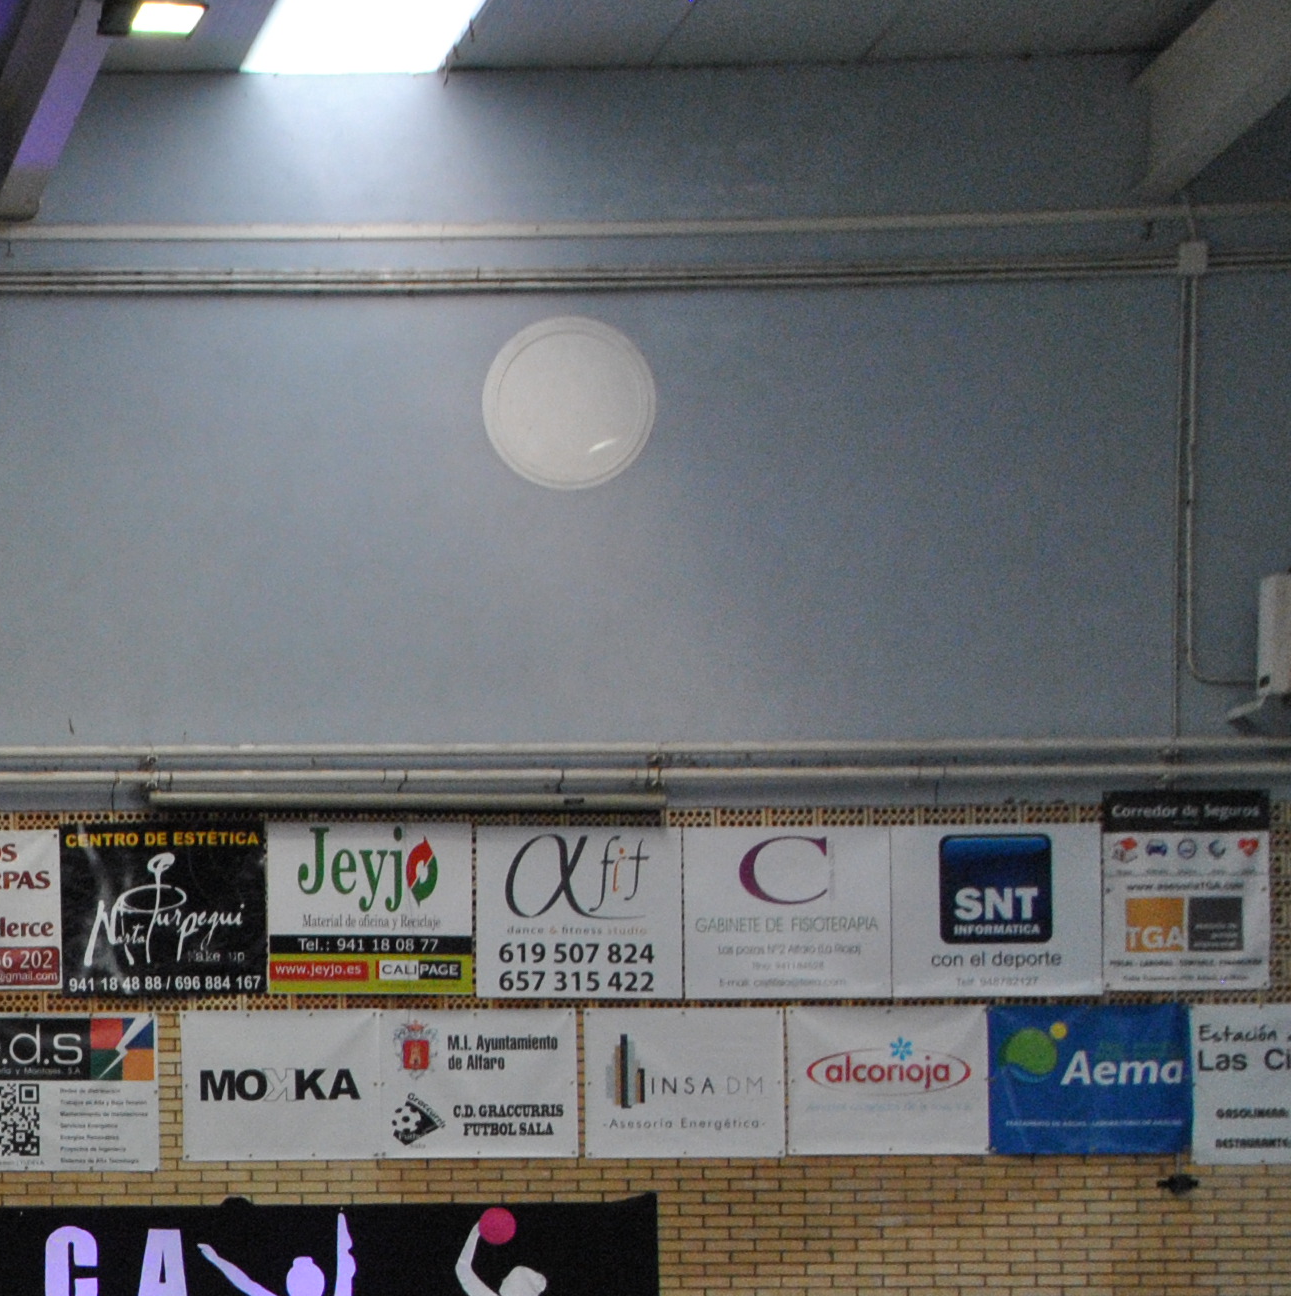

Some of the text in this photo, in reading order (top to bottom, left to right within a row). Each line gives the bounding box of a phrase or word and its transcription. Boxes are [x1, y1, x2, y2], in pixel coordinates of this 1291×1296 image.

[1111, 804, 1260, 819] Corredor de Seguros
[65, 828, 259, 847] CENTRO DE ESTÉTICA
[298, 825, 438, 912] Jeyjo
[954, 887, 1038, 921] SNT
[302, 914, 343, 928] Material
[345, 914, 357, 928] de
[358, 914, 389, 928] oficina
[506, 925, 545, 935] dance
[561, 925, 602, 935] fitness
[607, 925, 647, 935] studio
[695, 915, 879, 933] GABINETE DE FISIOTERAPIA
[954, 924, 1040, 936] INFORMATICA
[297, 937, 439, 951] Tel.: 941 18 08 77
[1126, 927, 1185, 949] TGA
[20, 949, 53, 969] 202
[498, 942, 655, 964] 619 507 824
[931, 951, 1062, 968] con el deporte
[275, 963, 362, 976] www.jeyjo.es
[381, 963, 459, 976] CALIPAGE
[69, 976, 95, 992] 941
[101, 976, 118, 992] 18
[122, 976, 140, 992] 48
[145, 976, 162, 991] 88
[175, 976, 201, 991] 696
[204, 975, 231, 990] 884
[235, 975, 261, 990] 167
[498, 971, 655, 992] 657 315 422
[1199, 1024, 1277, 1042] Estación
[447, 1034, 558, 1053] M.I. Ayuntamiento
[448, 1055, 505, 1070] de Alfaro
[1060, 1050, 1184, 1085] Aema
[1197, 1050, 1247, 1071] Las
[825, 1053, 950, 1089] alcorioja
[453, 1104, 564, 1118] C.D. GRACCURRIS
[463, 1122, 554, 1136] FUTBOL SALA
